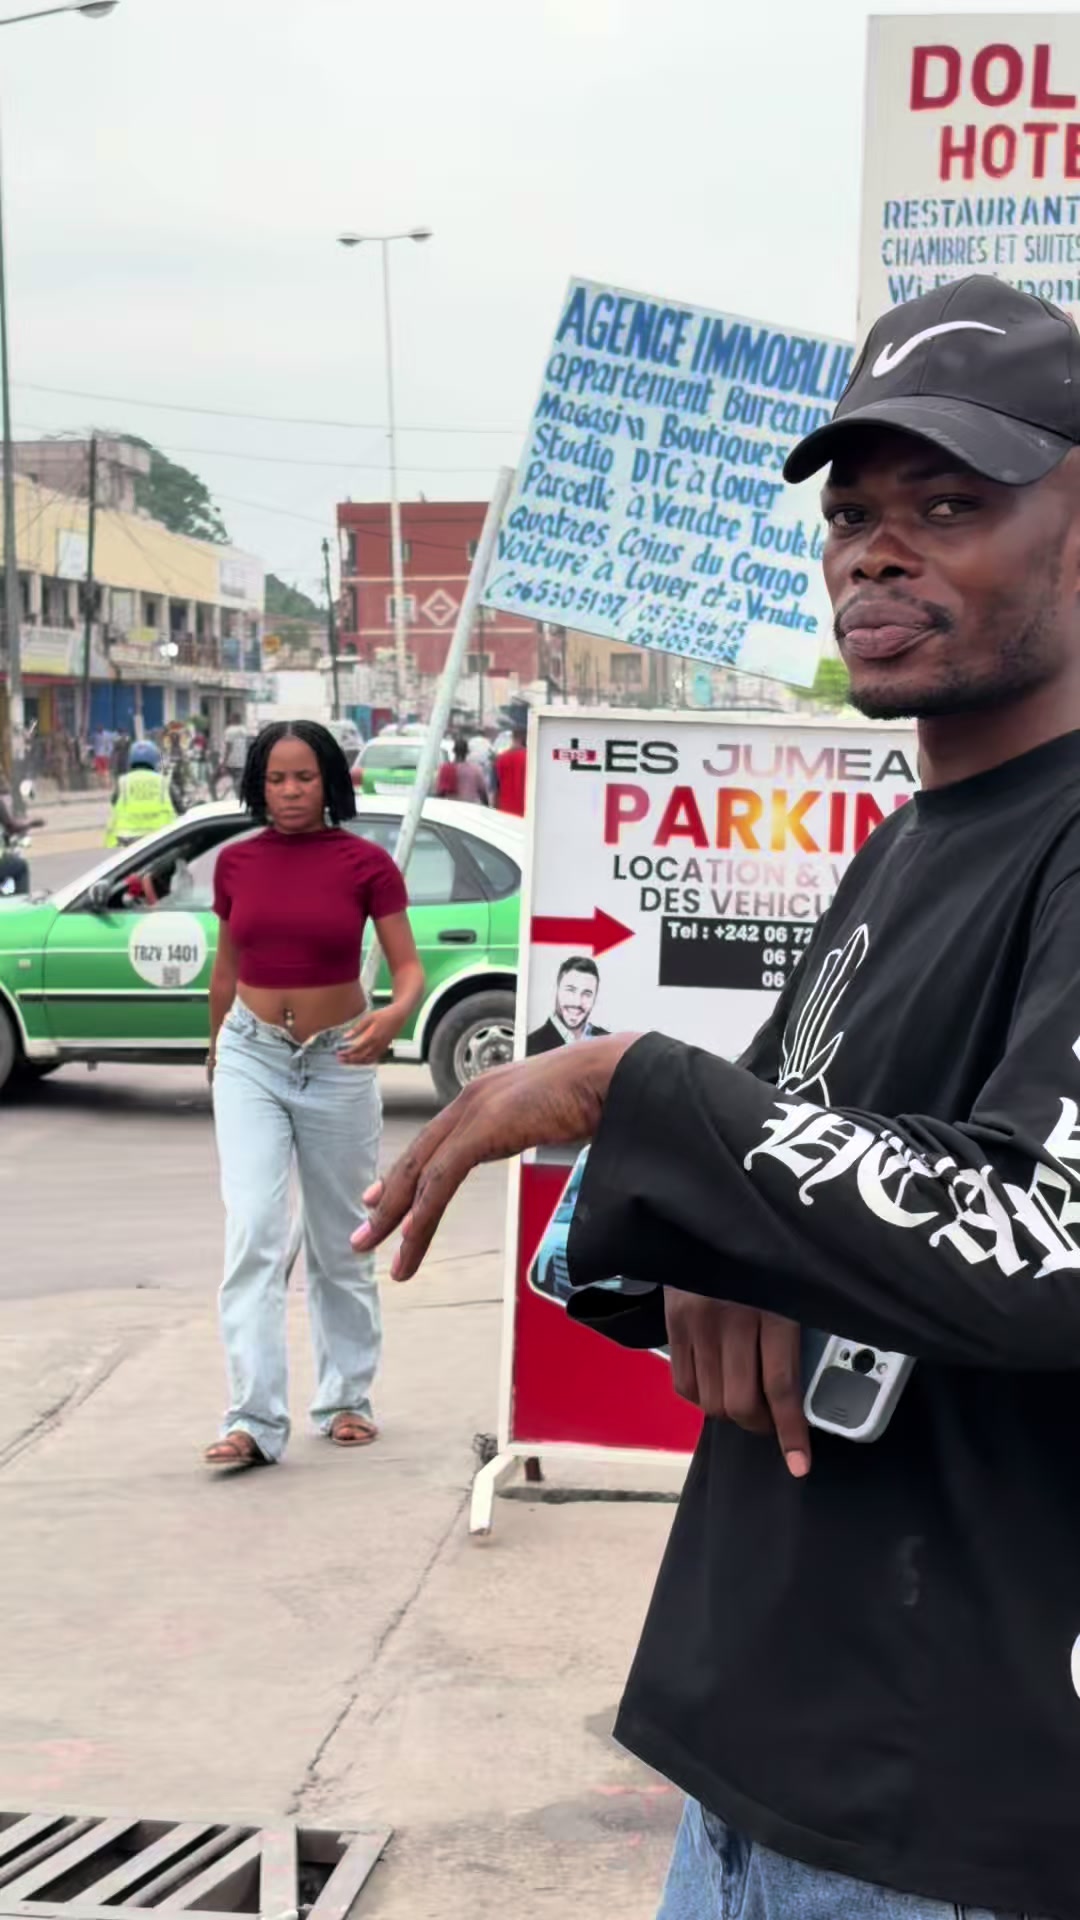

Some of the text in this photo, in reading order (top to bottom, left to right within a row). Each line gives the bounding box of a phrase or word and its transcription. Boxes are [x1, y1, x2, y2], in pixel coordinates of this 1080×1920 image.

[911, 44, 1077, 110] DOL
[882, 236, 988, 267] CHAMBRES
[995, 234, 1018, 265] ET
[555, 287, 693, 368] AGENCE
[545, 351, 716, 416] appartement
[531, 423, 614, 474] Studio
[631, 447, 682, 489] DTC
[659, 413, 790, 472] Boutiques
[625, 486, 646, 520] à
[652, 492, 742, 542] Vendre
[507, 504, 809, 600] Quatres Coins du Congo
[497, 529, 589, 576] Voiture
[592, 551, 614, 583] à
[746, 588, 819, 634] Vendre
[571, 738, 679, 774] LES
[703, 743, 916, 784] JUMEA
[613, 854, 786, 888] LOCATION
[796, 861, 820, 888] &
[640, 886, 701, 914] DES
[167, 943, 199, 962] 1401
[667, 921, 698, 940] Tel
[714, 924, 760, 942] +242
[764, 926, 788, 944] 06
[762, 948, 786, 966] 06
[761, 970, 785, 989] 06
